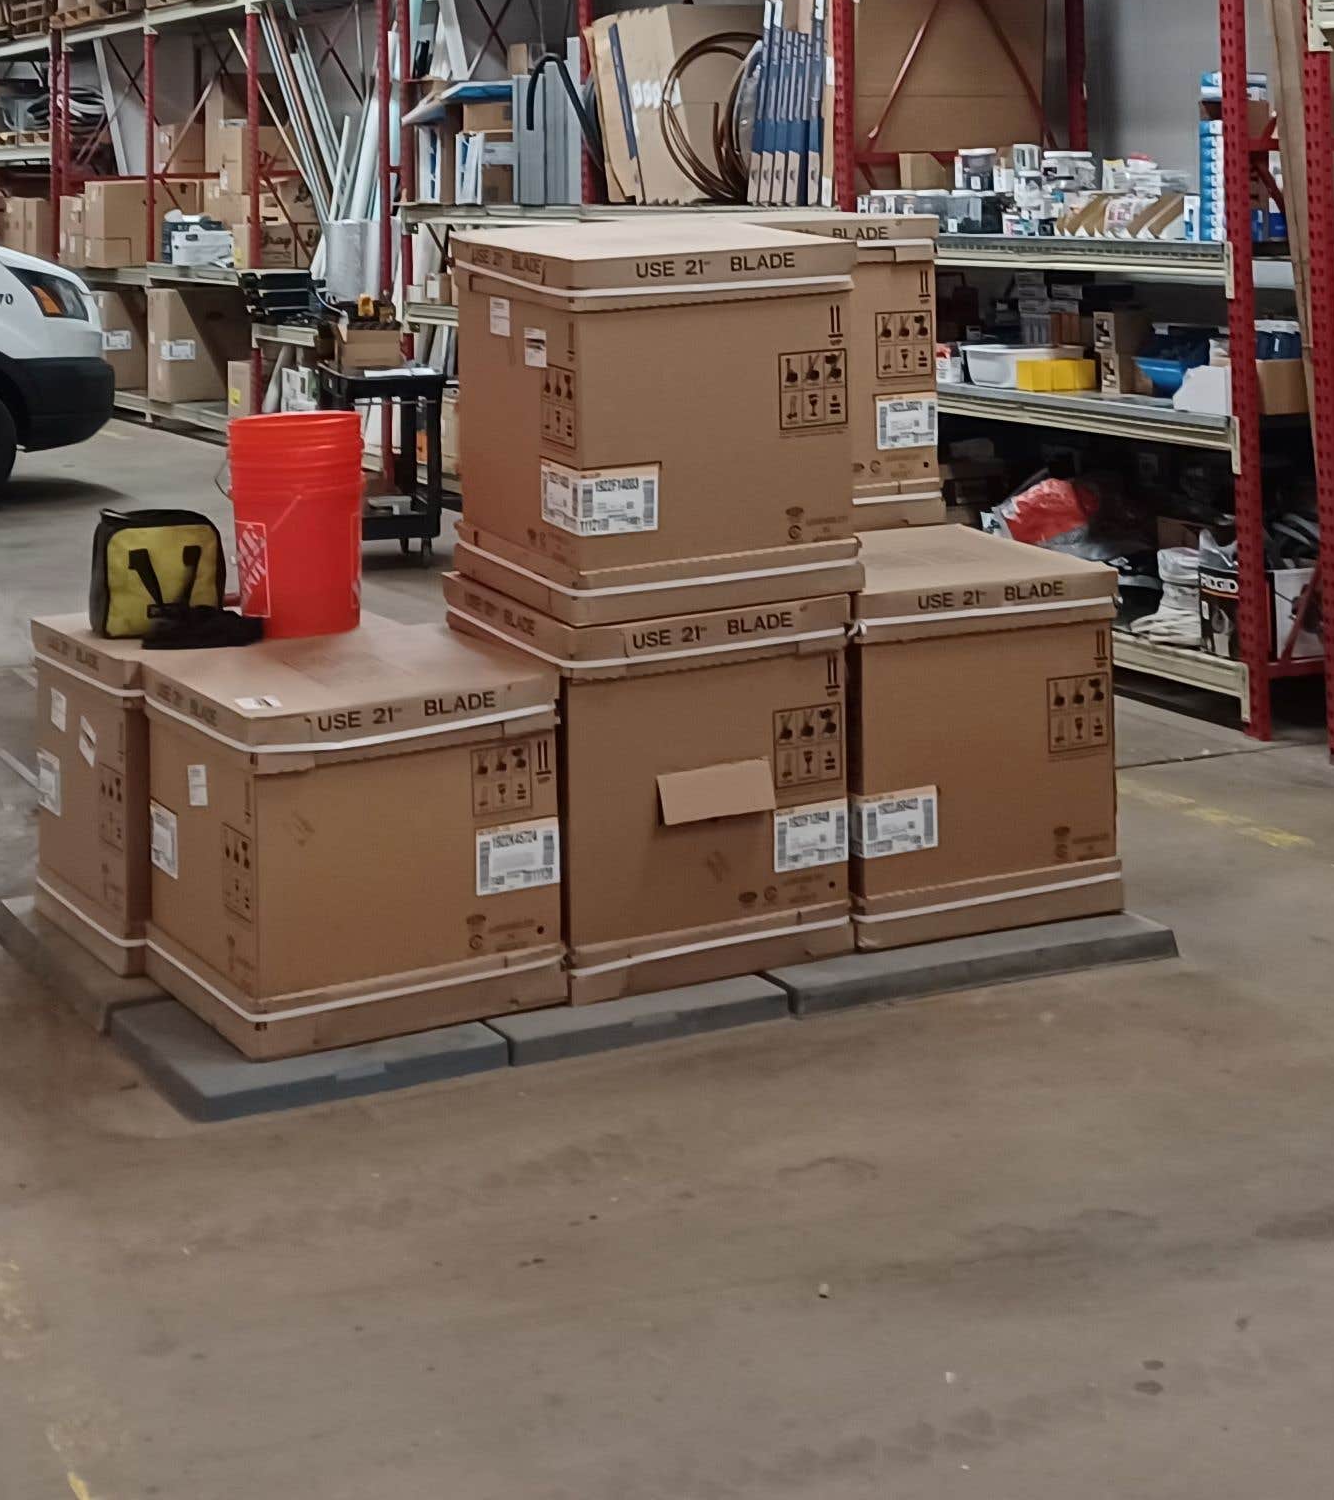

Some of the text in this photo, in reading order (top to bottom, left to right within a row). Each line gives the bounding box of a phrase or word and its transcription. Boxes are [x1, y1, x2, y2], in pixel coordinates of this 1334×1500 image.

[832, 227, 889, 240] BLADE
[636, 261, 675, 278] USE
[730, 252, 795, 272] BLADE
[918, 591, 955, 610] USE
[1004, 581, 1064, 601] BLADE
[632, 629, 672, 649] USE
[727, 612, 794, 635] BLADE
[318, 711, 362, 732] USE
[424, 690, 496, 717] BLADE
